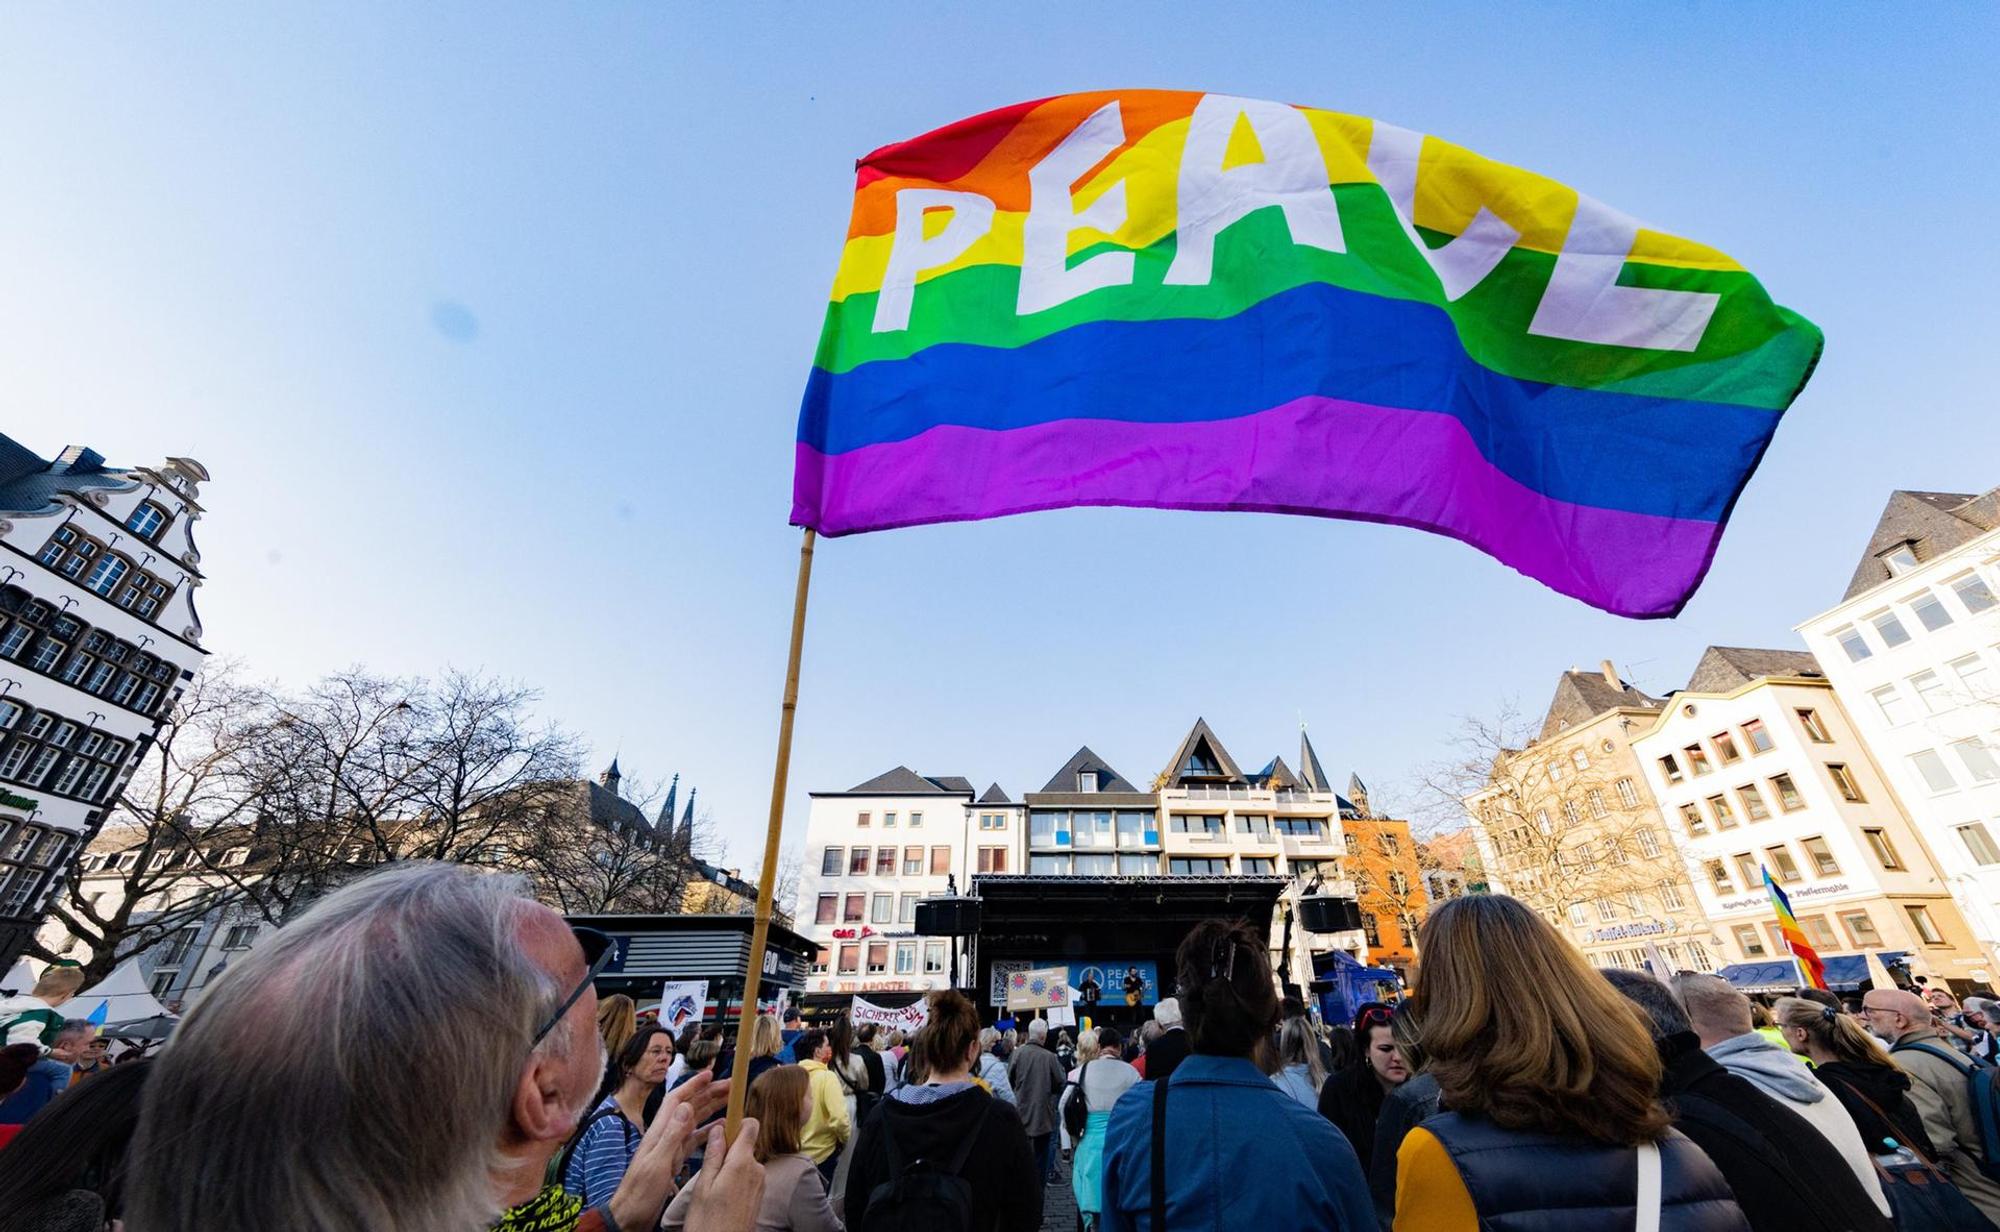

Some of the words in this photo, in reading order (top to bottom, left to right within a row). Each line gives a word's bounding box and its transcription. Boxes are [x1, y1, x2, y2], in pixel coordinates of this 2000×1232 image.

[832, 929, 856, 939] GAG
[1107, 969, 1146, 979] PEAE
[1107, 979, 1152, 990] PLE
